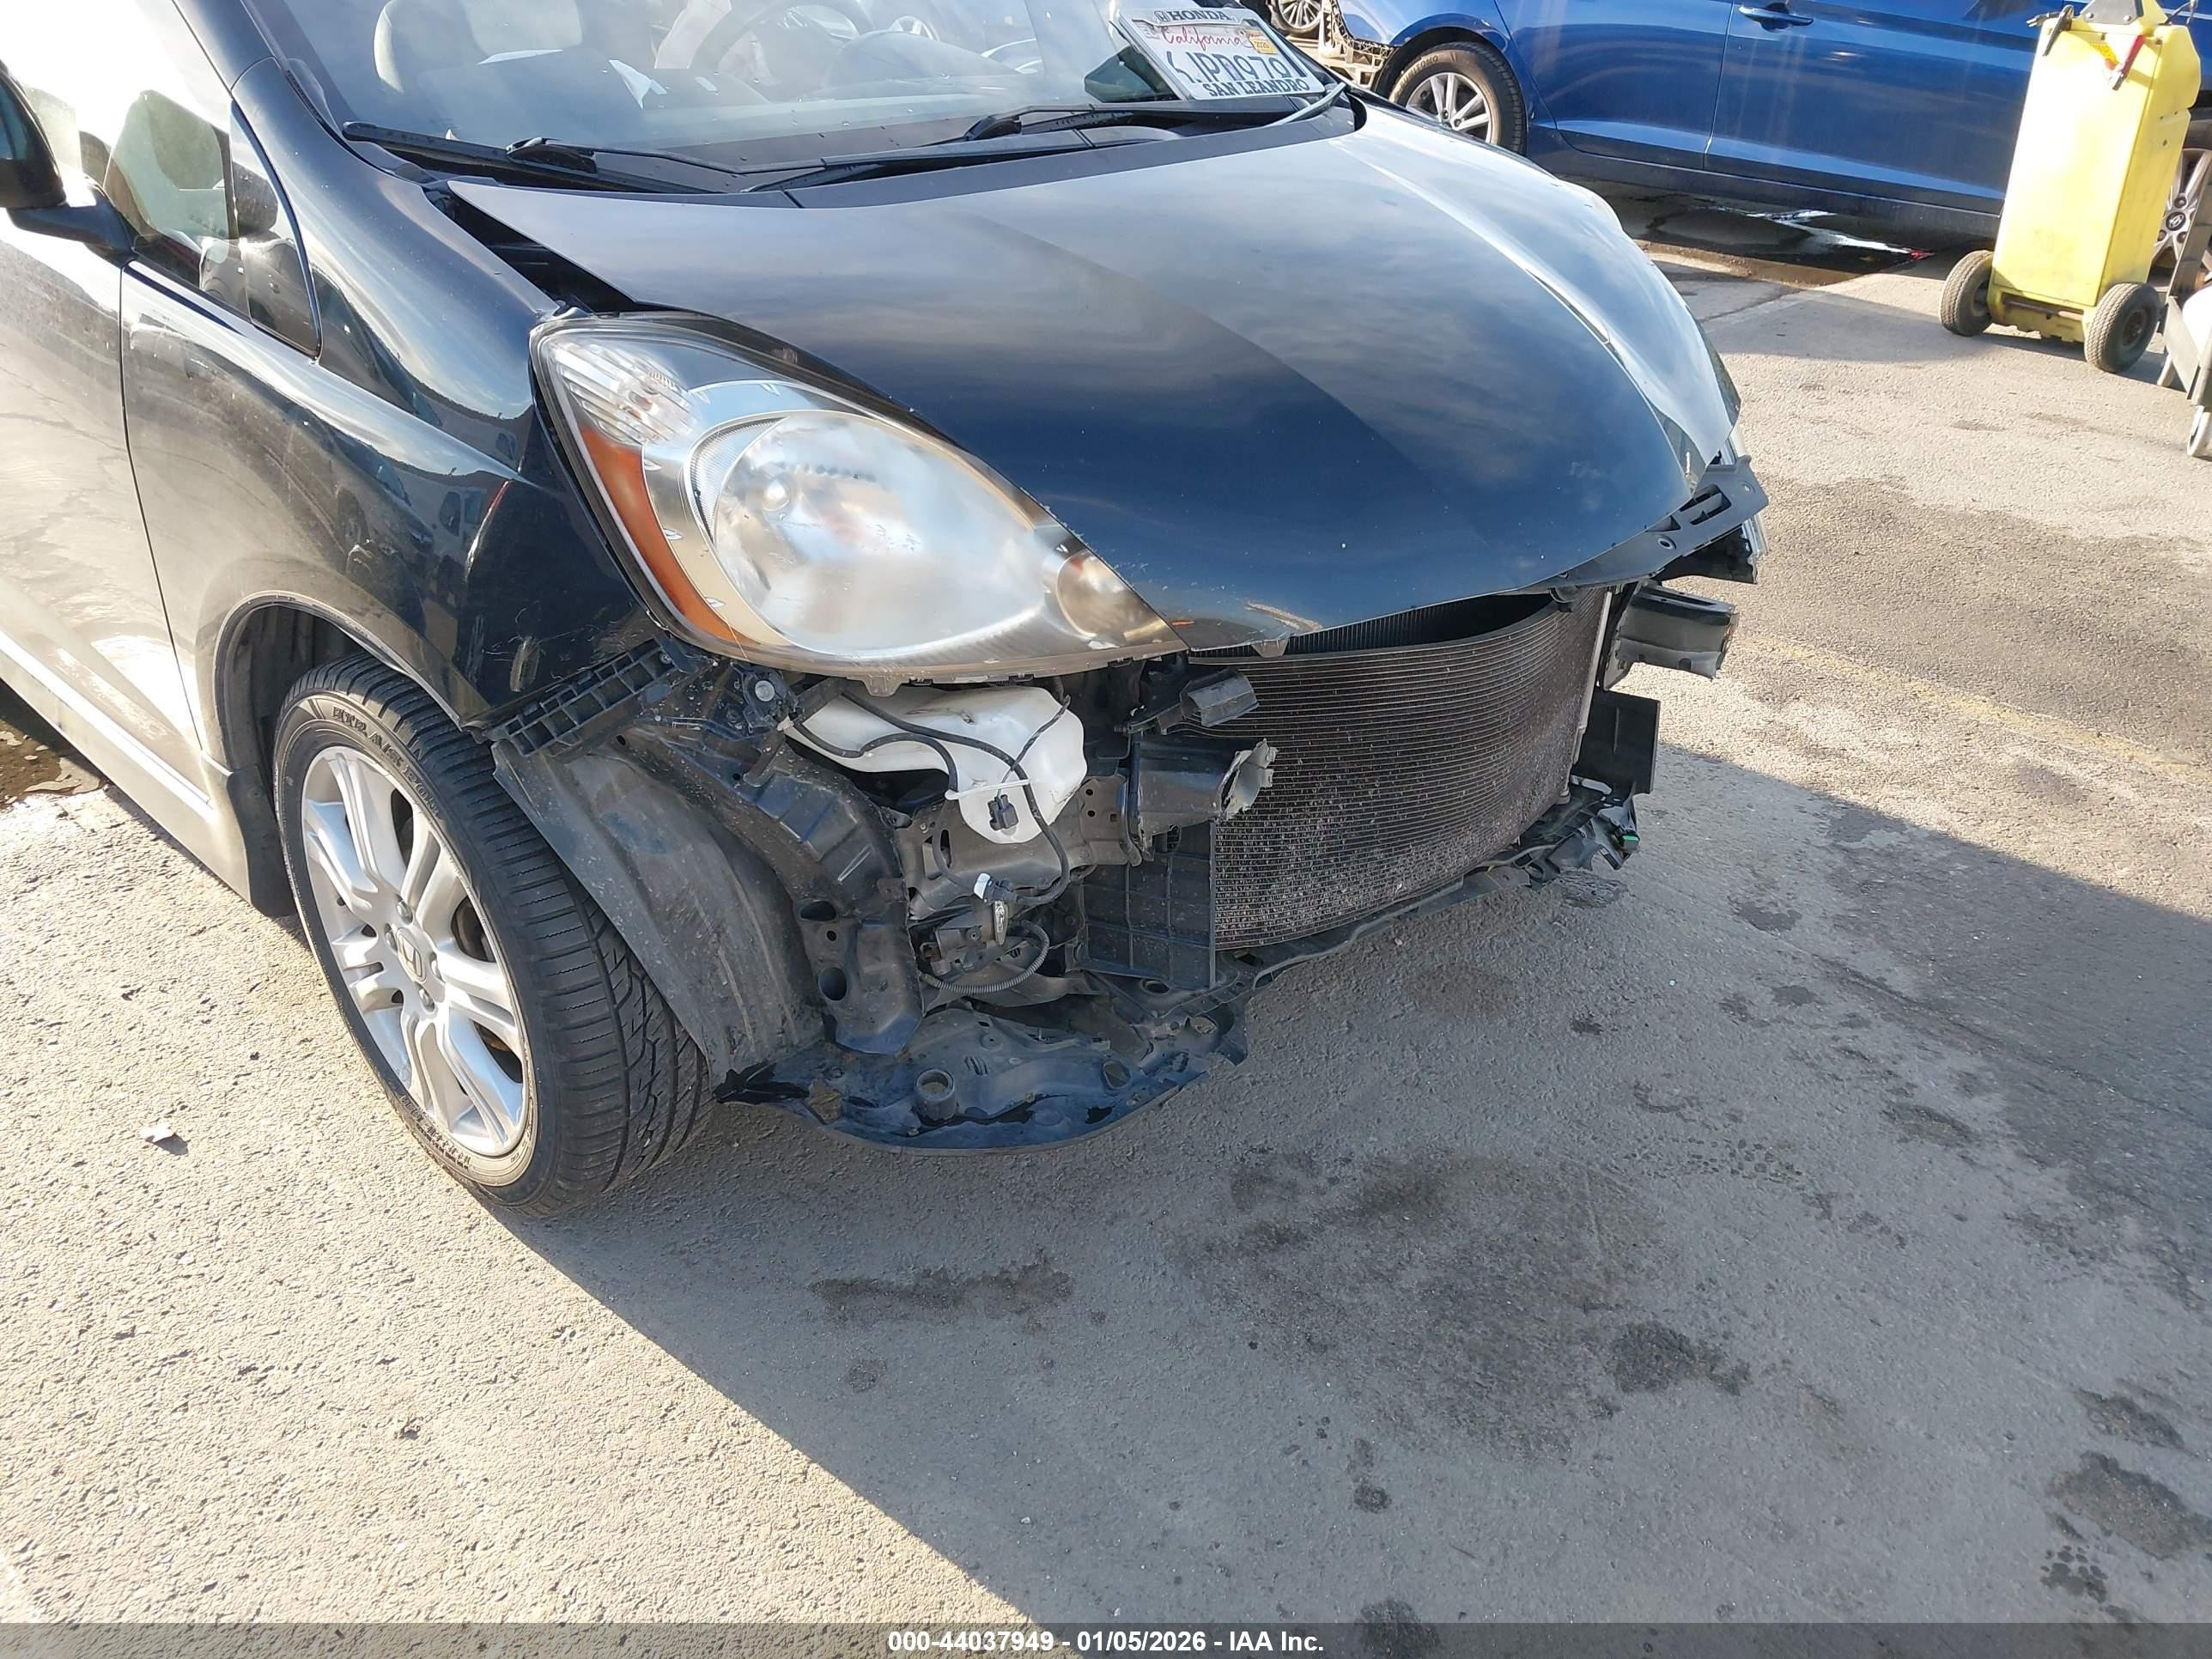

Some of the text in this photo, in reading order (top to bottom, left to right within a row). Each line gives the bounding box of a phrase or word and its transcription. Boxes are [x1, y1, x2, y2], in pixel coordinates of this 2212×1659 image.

[1167, 10, 1232, 21] HONDA
[1161, 26, 1243, 51] California
[1202, 78, 1310, 97] SAN LEANDRO
